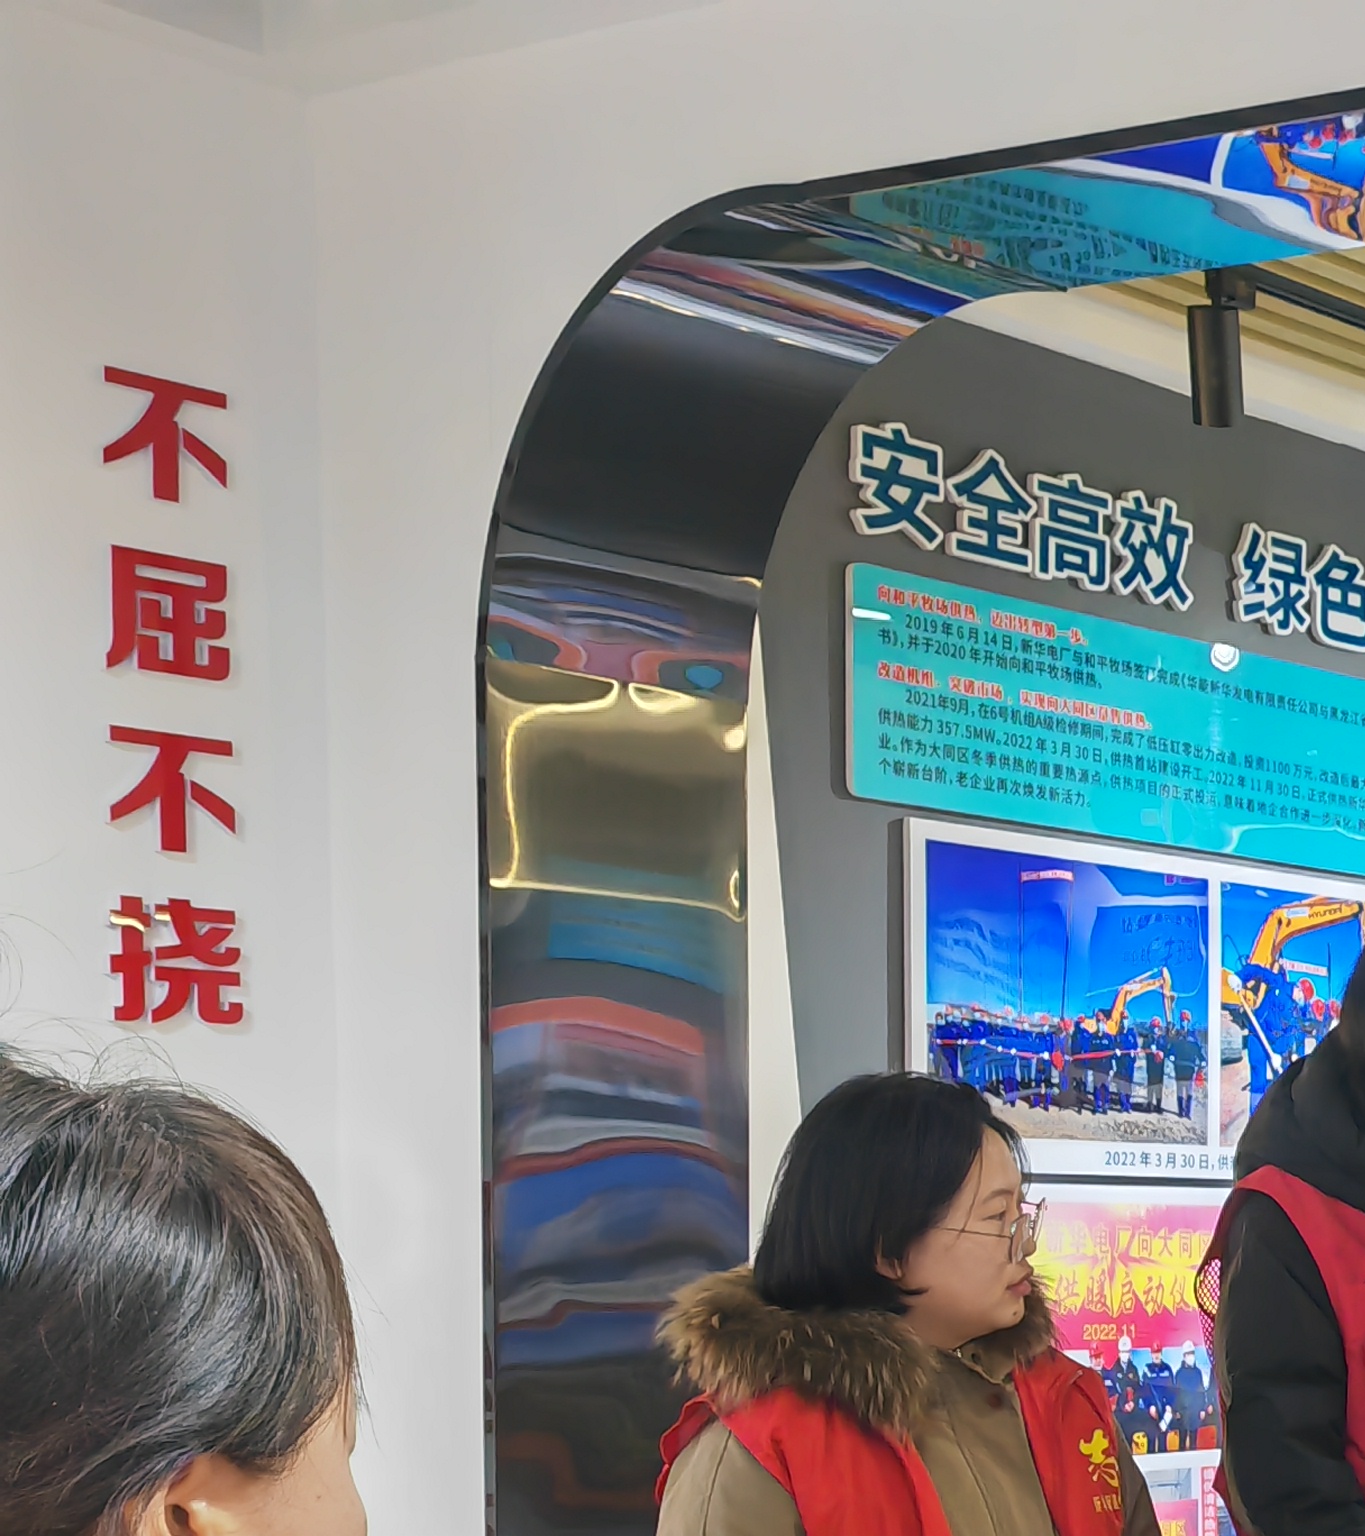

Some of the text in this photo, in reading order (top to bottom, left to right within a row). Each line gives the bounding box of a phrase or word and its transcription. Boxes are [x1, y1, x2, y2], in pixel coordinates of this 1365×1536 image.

[102, 364, 244, 1024] 不屈不挠
[852, 424, 1193, 611] 安全高效
